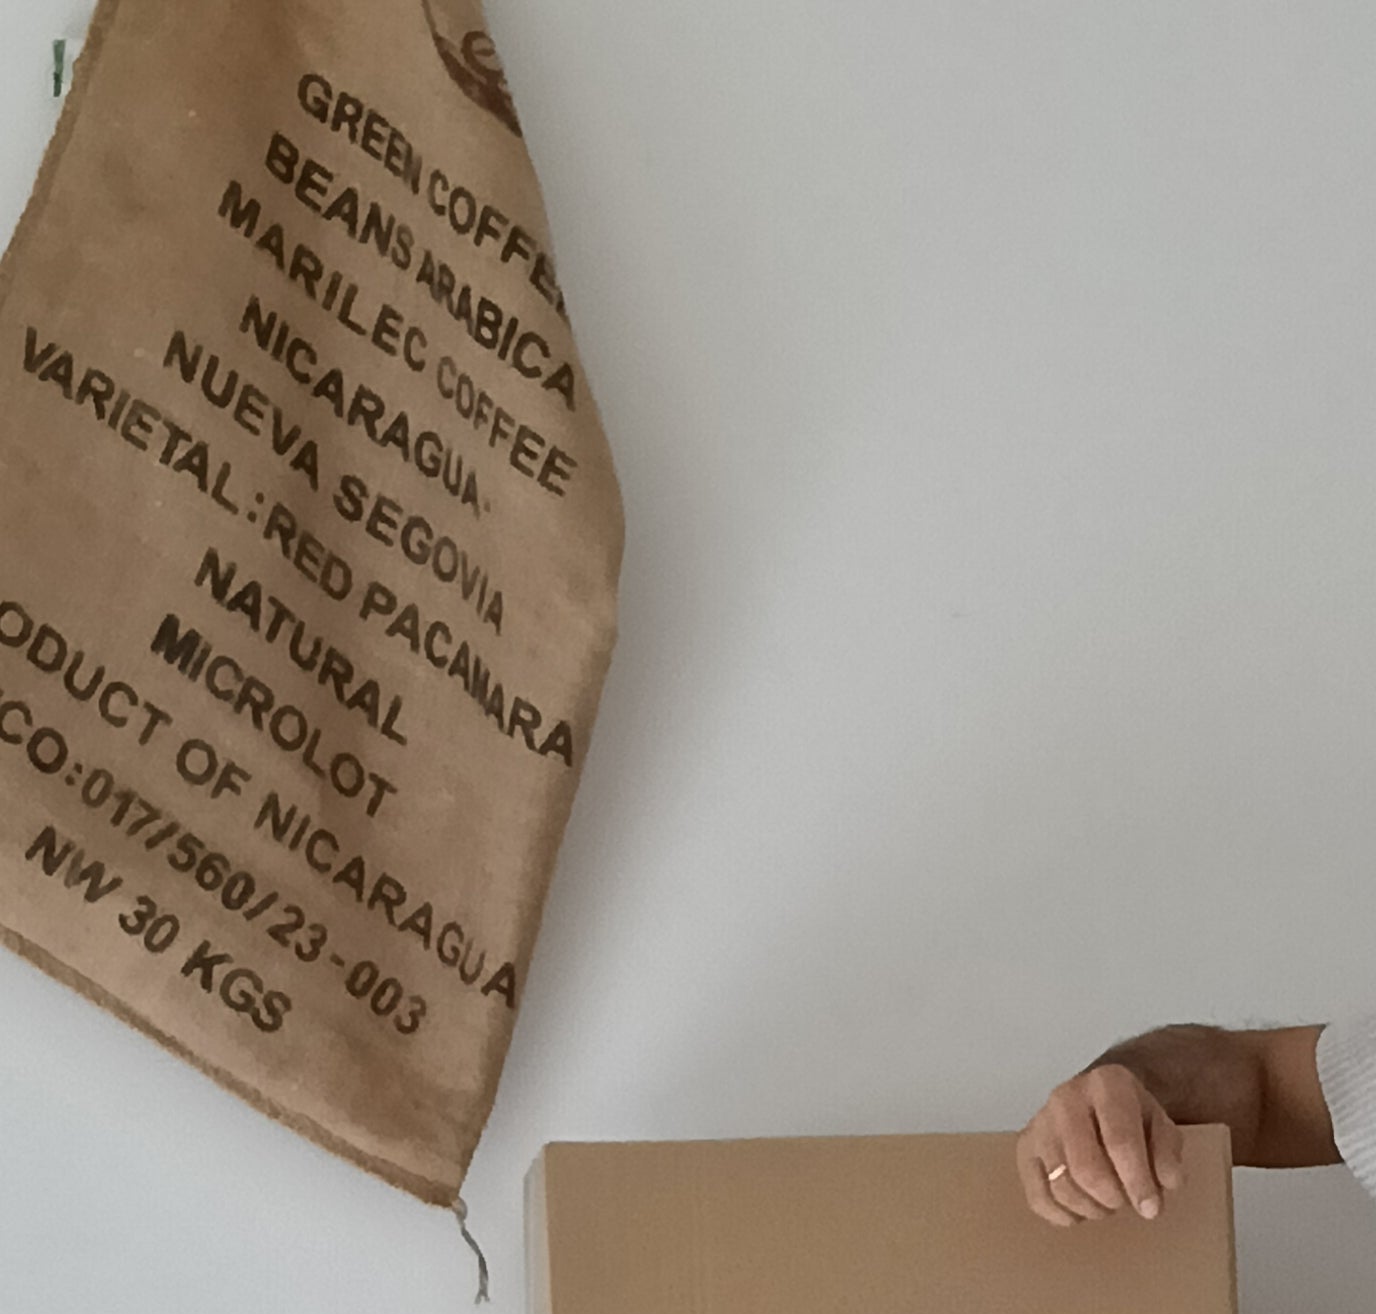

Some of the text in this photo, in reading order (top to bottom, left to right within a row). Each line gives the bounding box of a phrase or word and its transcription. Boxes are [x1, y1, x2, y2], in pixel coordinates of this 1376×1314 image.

[217, 180, 578, 497] MARILEC COFFEE
[265, 131, 576, 410] BEANS ARABICA
[427, 169, 568, 319] COFFE
[163, 329, 503, 637] NUEVA SEGOVIA
[150, 613, 397, 818] MICROLOT
[194, 547, 407, 746] NATURAL
[25, 826, 292, 1034] NW 30 KGS
[176, 738, 252, 799] OF
[254, 792, 517, 1009] NICARAGUA
